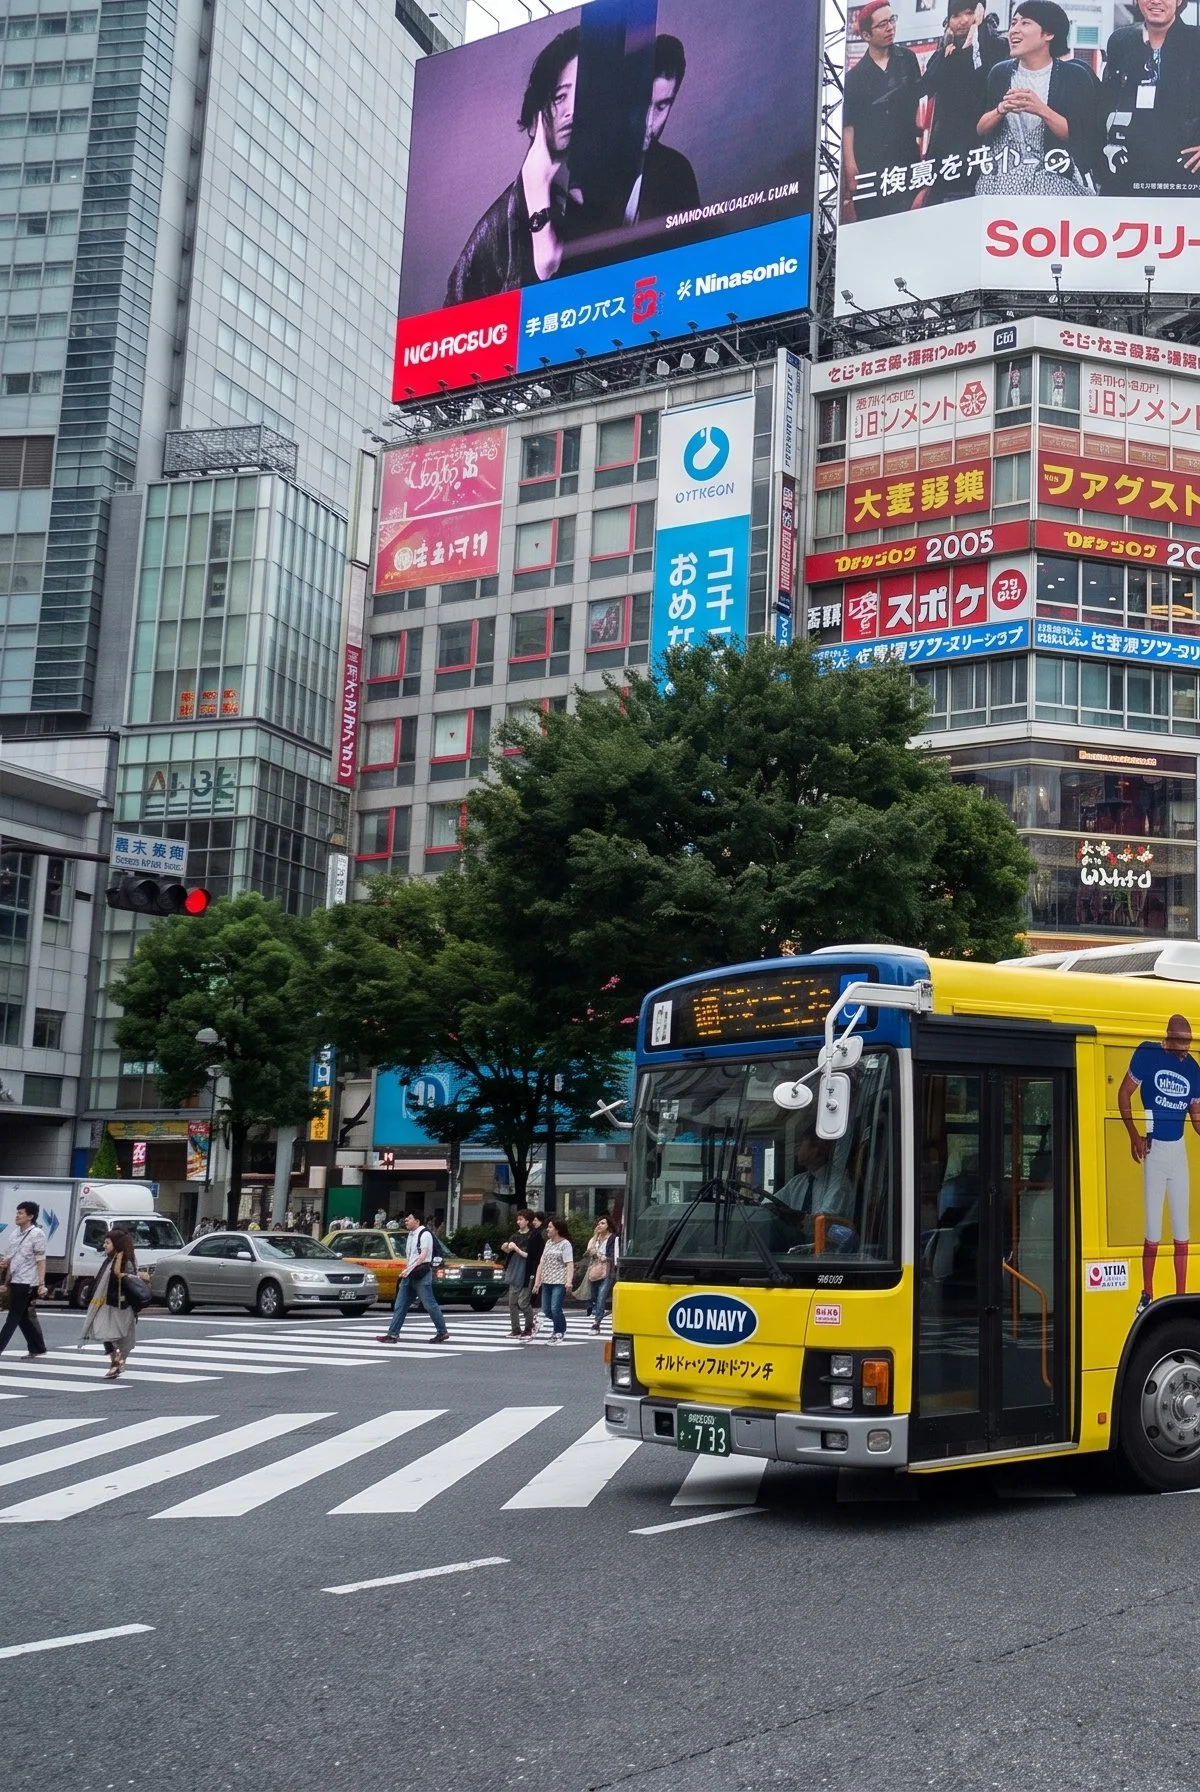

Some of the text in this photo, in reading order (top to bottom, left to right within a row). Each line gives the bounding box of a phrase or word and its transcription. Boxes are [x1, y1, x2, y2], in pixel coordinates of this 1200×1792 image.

[695, 256, 798, 296] Ninasonic
[926, 528, 994, 563] 2005
[675, 1307, 748, 1333] OLD NAVY
